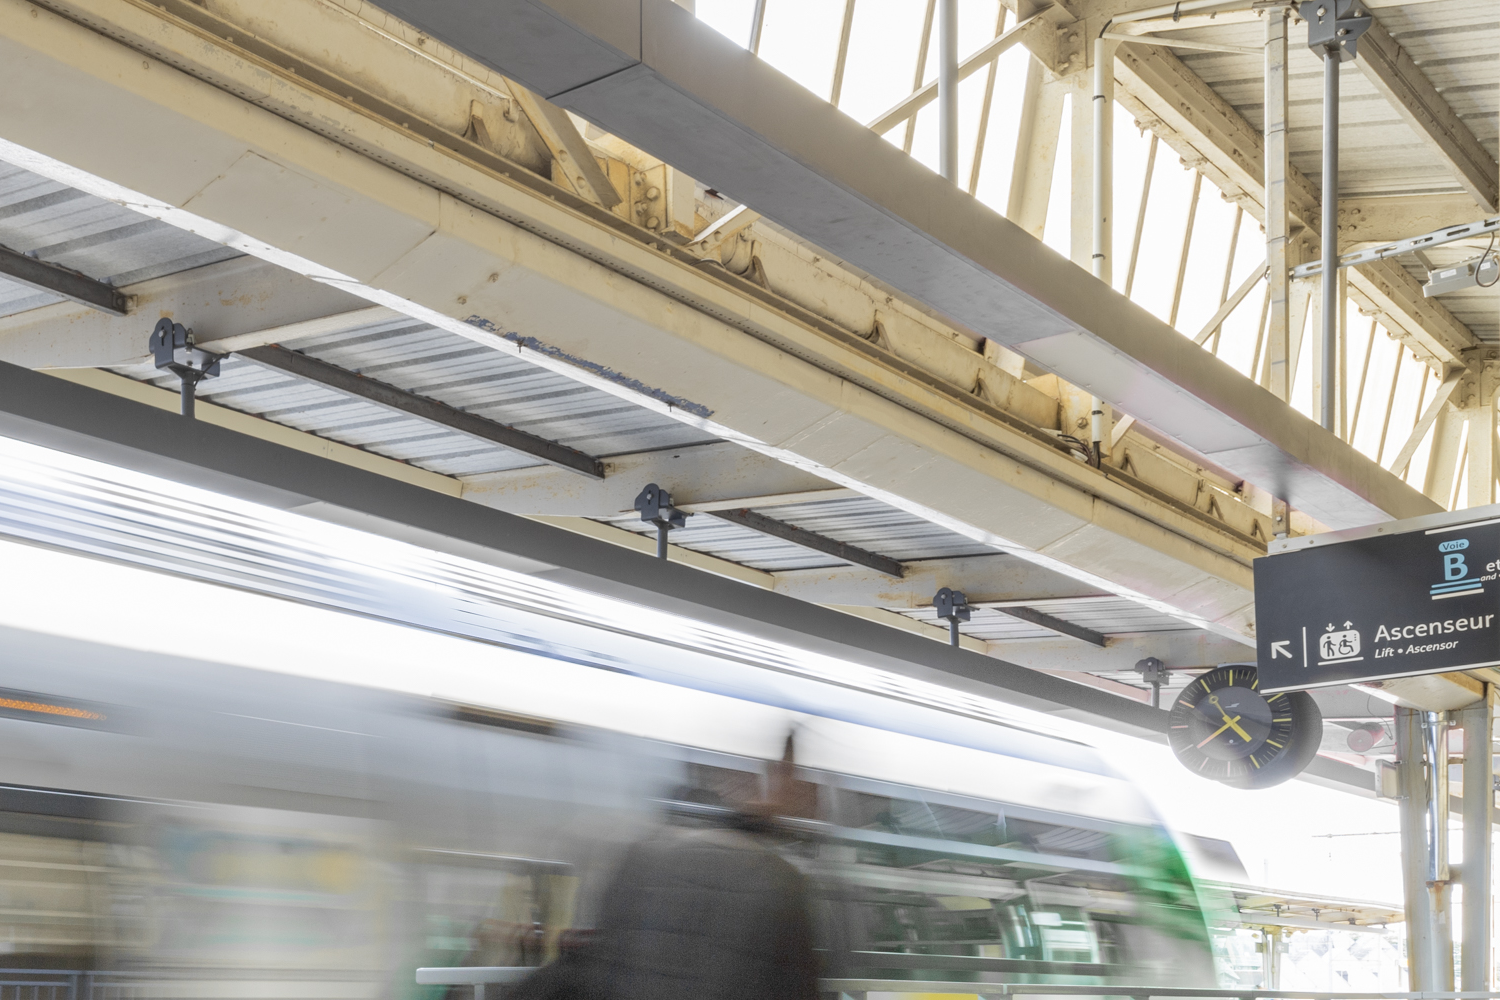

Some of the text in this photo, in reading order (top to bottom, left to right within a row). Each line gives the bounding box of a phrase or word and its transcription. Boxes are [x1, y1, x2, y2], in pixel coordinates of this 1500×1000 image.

[1442, 541, 1465, 551] Voie
[1444, 553, 1468, 581] B
[1480, 573, 1497, 582] and
[1374, 614, 1494, 643] Ascenseur
[1374, 641, 1459, 659] Lift Ascensor
